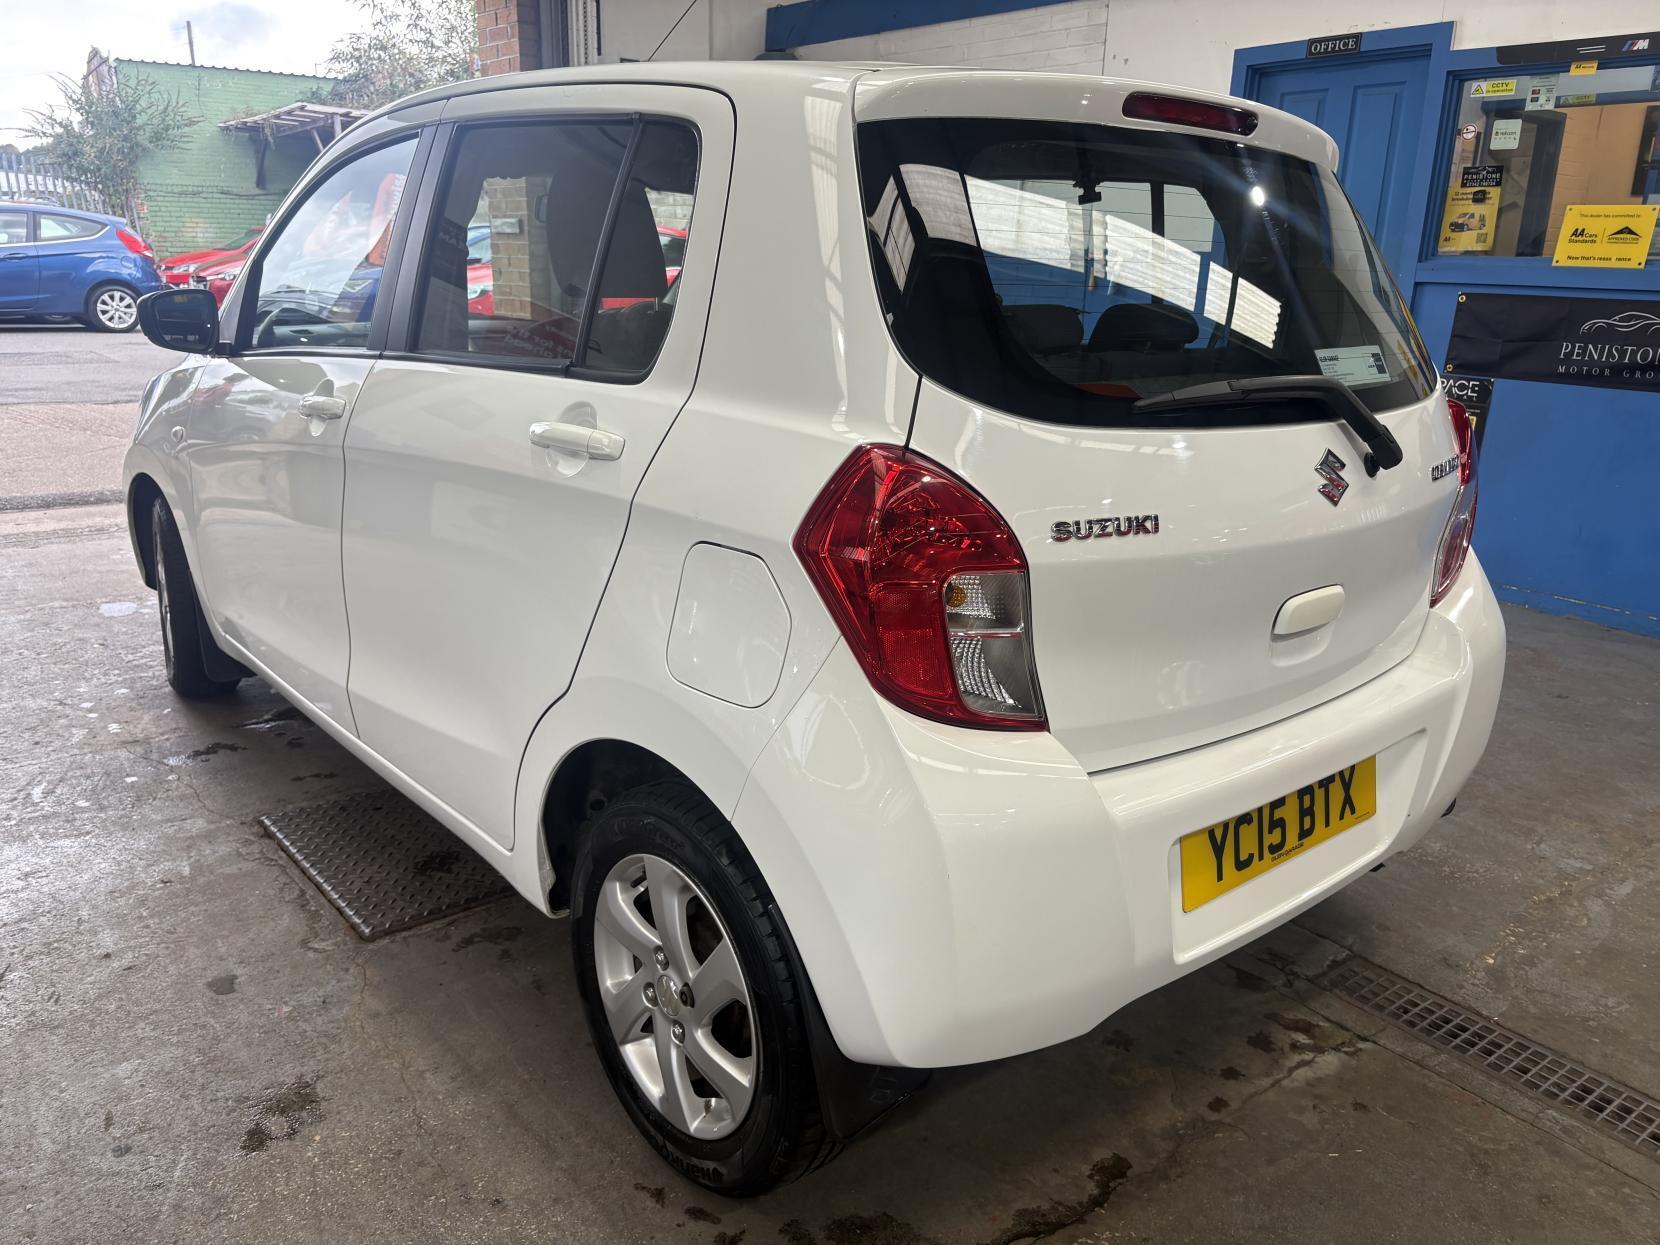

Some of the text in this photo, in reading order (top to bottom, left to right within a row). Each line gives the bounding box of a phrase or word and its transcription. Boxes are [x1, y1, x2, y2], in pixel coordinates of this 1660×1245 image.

[1311, 38, 1357, 54] OFFICE
[1491, 81, 1510, 89] CCTV
[1463, 172, 1501, 180] PENISTONE
[1570, 228, 1585, 238] AA
[1557, 364, 1611, 377] MOTOR
[1050, 514, 1160, 543] SUZUKI
[1207, 763, 1357, 883] YC15 BTX
